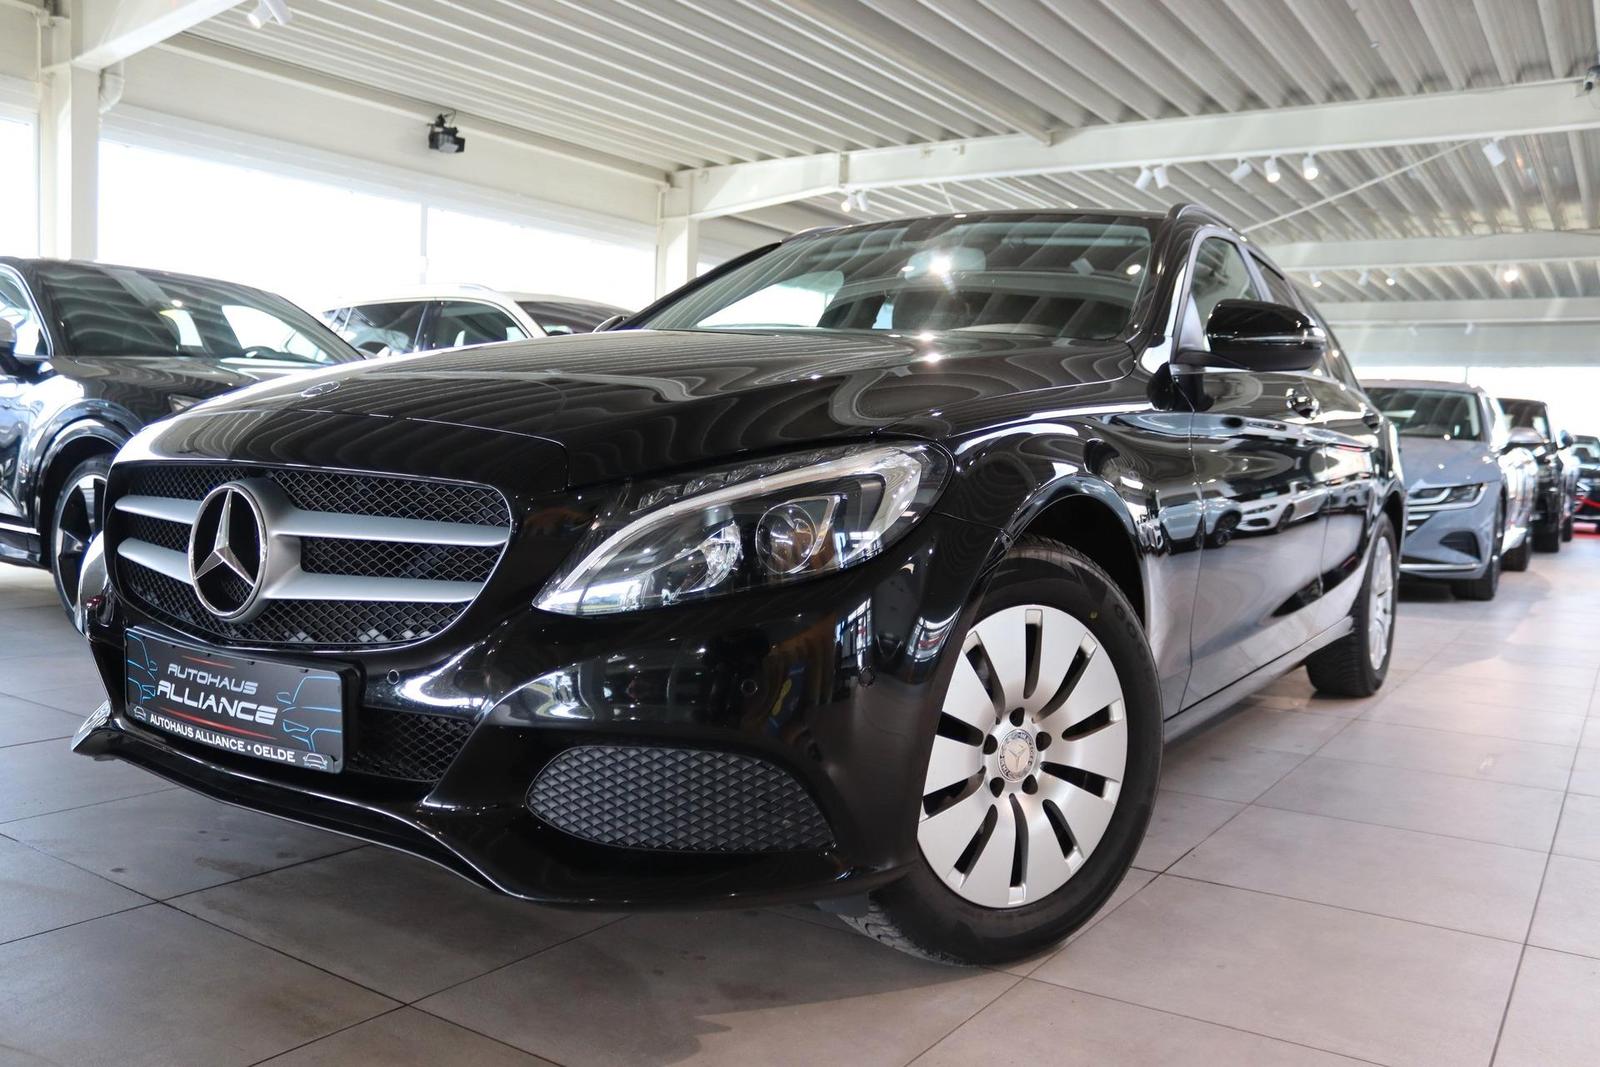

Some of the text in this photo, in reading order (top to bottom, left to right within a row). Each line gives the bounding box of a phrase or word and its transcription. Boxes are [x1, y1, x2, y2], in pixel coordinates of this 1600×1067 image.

[167, 663, 258, 696] AUTOHAUS
[157, 680, 279, 726] ALLIANCE
[150, 713, 296, 763] AUTOHAUS ALLIANCE OELDE
